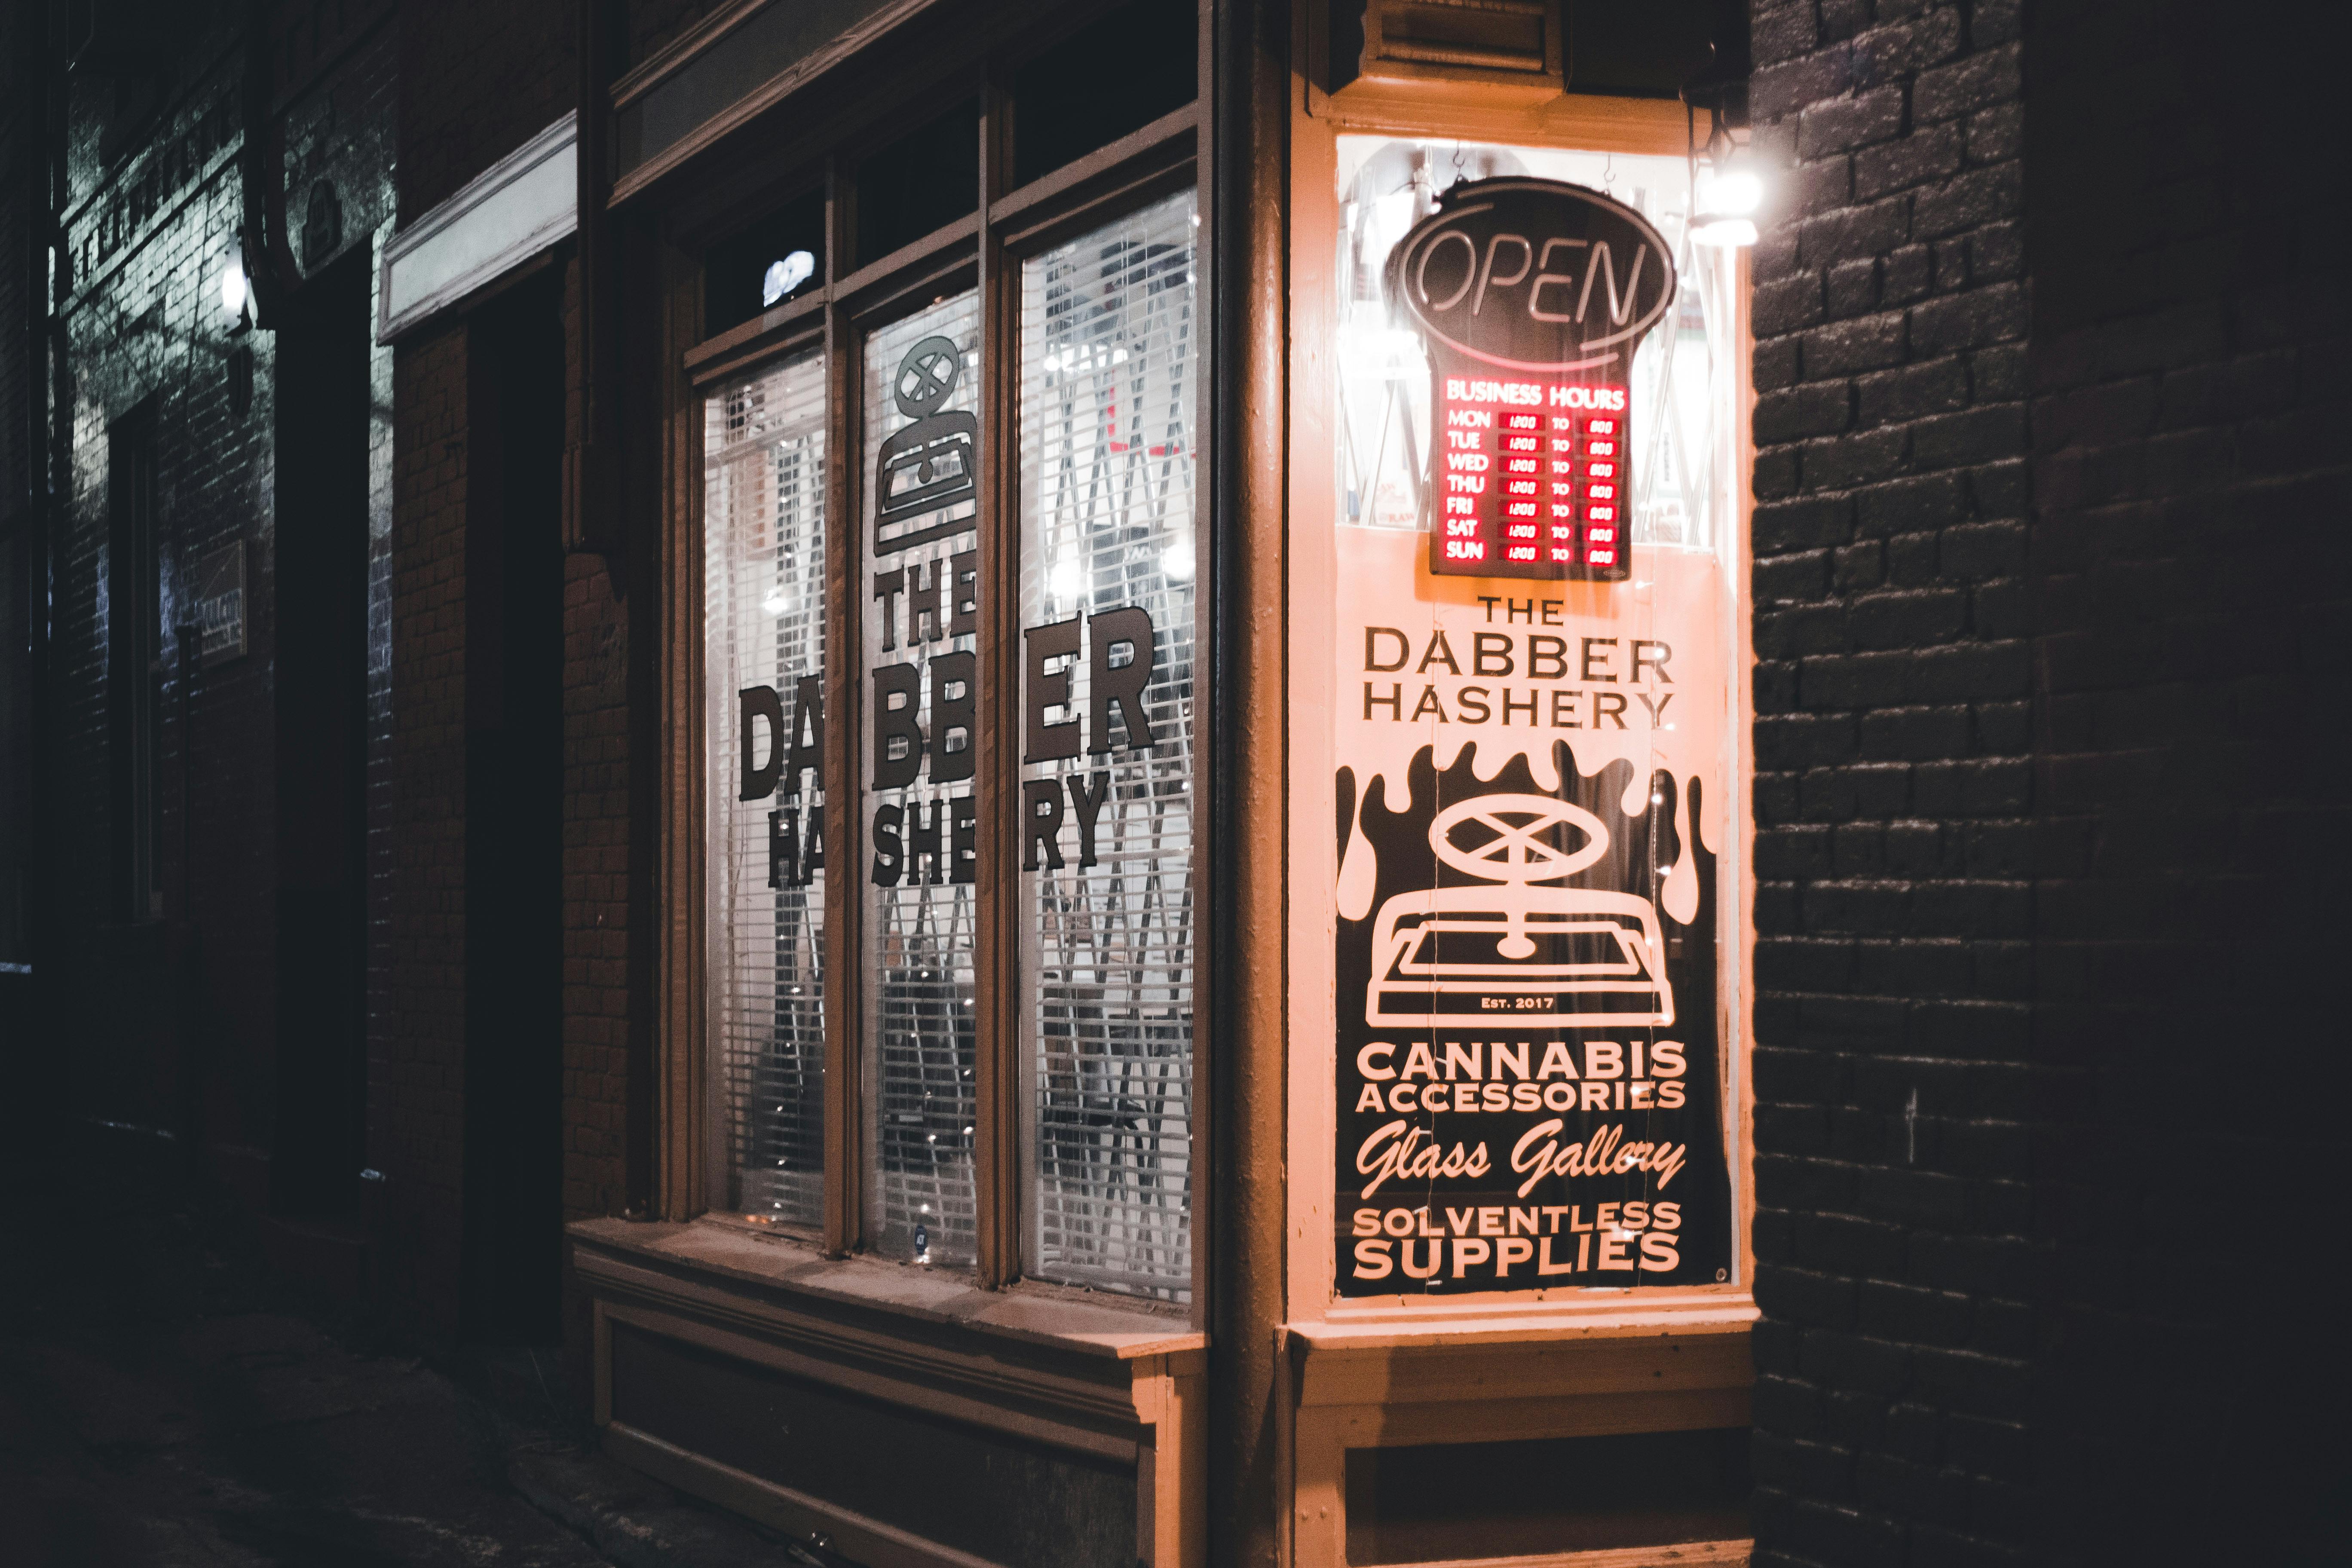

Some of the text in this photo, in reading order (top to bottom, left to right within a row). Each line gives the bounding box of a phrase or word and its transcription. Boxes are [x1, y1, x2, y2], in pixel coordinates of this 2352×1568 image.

[1417, 230, 1646, 325] OPEN
[1447, 380, 1625, 411] BUSINESS HOURS
[1449, 410, 1491, 428] MON
[1552, 417, 1569, 430] TO
[1448, 431, 1480, 449] TUE
[1552, 439, 1569, 451] TO
[1448, 453, 1488, 471] WED
[1552, 461, 1569, 473] TO
[1447, 475, 1484, 493] THU
[1552, 483, 1569, 495] TO
[1447, 497, 1473, 514] FRI
[1552, 505, 1569, 517] TO
[1447, 519, 1477, 536] SAT
[1552, 527, 1569, 539] TO
[1447, 541, 1482, 559] SUN
[1552, 548, 1569, 560] TO
[874, 549, 977, 652] THE
[1477, 595, 1564, 627] THE
[1363, 626, 1674, 683] DABBER
[1363, 682, 1675, 730] HASHERY
[1516, 997, 1554, 1009] 2017
[1357, 1040, 1687, 1081] CANNABIS
[1355, 1081, 1686, 1112] ACCESSORIES
[1356, 1118, 1686, 1200] Glass Gallery
[1352, 1201, 1681, 1237] SOLVENTLESS
[1353, 1232, 1680, 1279] SUPPLIES
